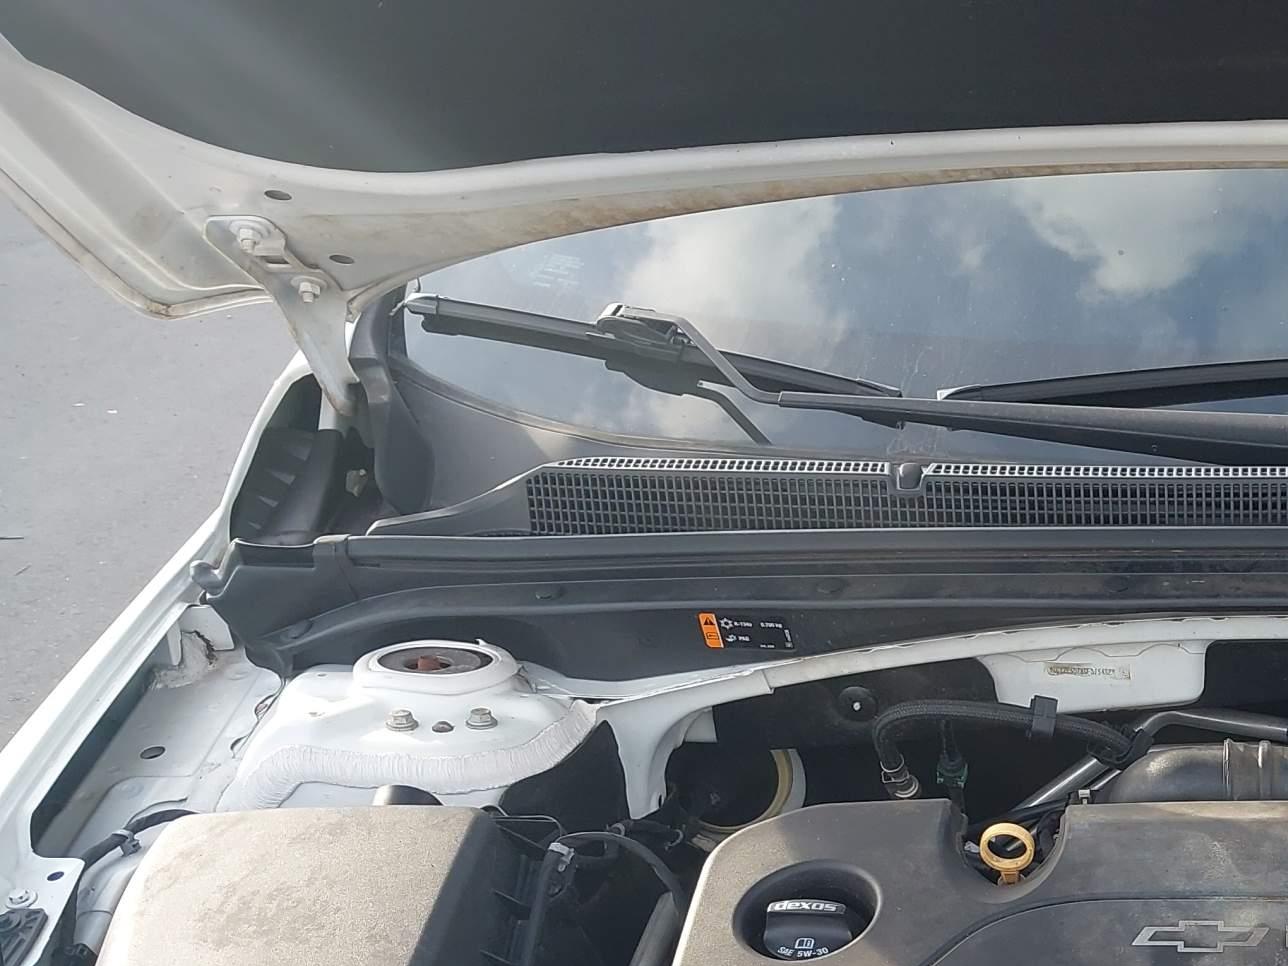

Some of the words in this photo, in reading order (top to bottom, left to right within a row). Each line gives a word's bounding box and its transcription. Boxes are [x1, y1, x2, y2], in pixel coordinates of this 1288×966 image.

[774, 900, 837, 912] dexos
[777, 946, 795, 957] SAE
[797, 947, 829, 958] 5W-30
